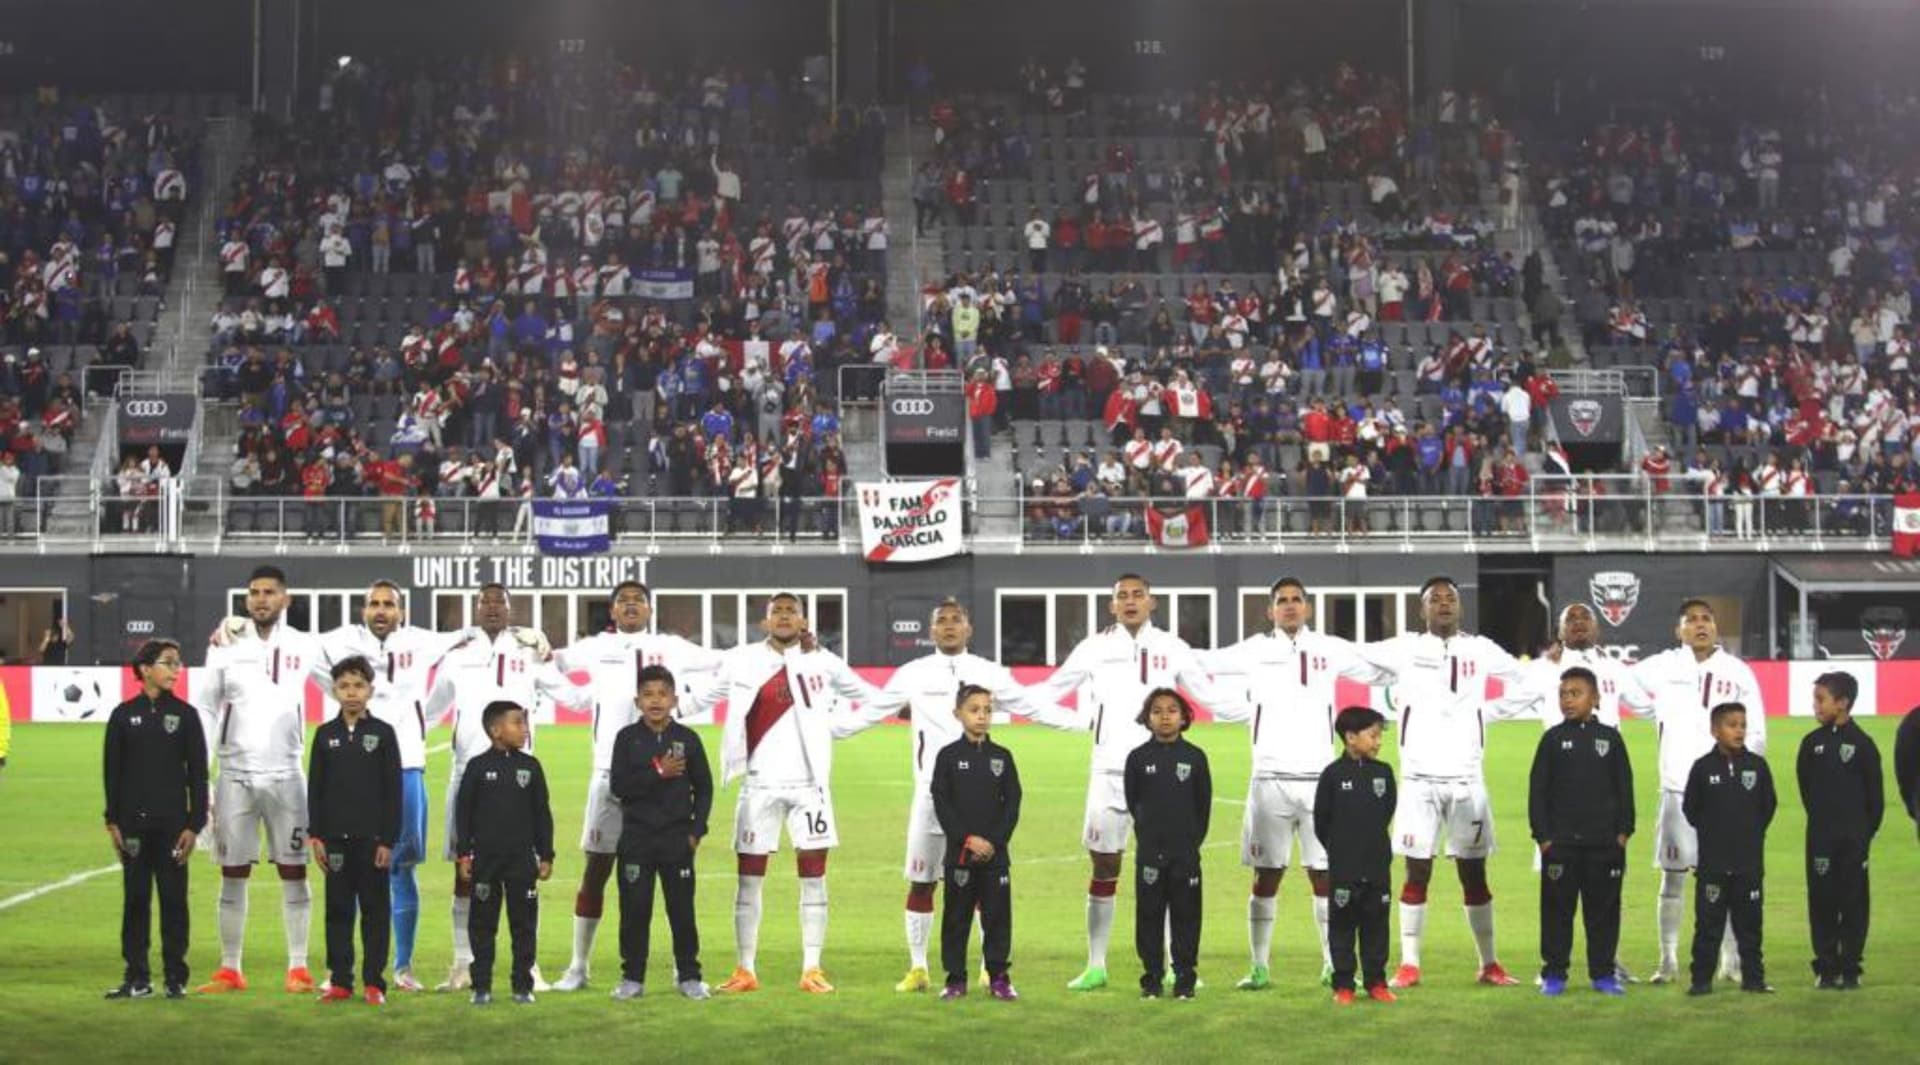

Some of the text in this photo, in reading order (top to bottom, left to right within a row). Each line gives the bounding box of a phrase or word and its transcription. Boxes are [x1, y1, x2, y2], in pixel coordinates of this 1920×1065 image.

[872, 509, 947, 529] PAJUELO
[881, 529, 943, 548] GARCIA
[413, 556, 650, 587] UNITE THE DISTRICT
[804, 810, 828, 835] 16
[1471, 820, 1484, 844] 7
[291, 826, 303, 850] 5
